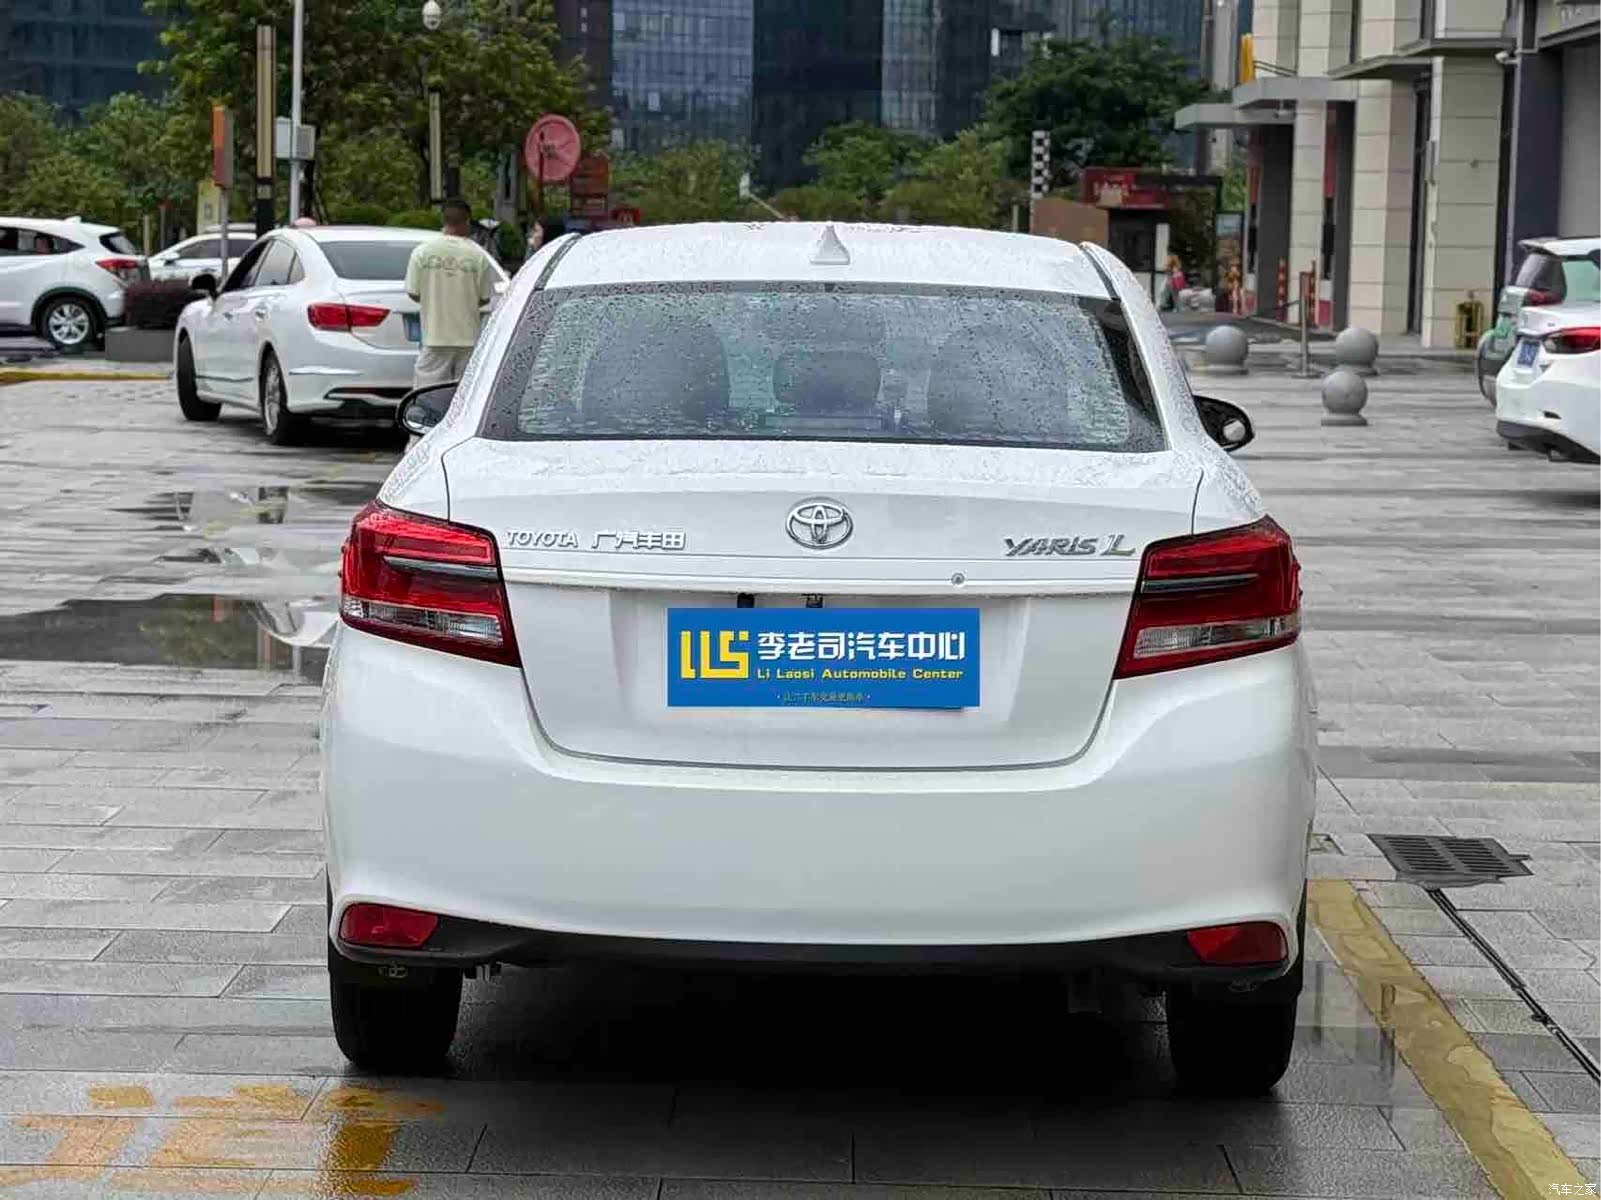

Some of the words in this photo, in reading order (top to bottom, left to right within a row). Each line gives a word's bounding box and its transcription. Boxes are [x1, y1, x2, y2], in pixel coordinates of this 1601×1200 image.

[506, 530, 579, 548] TOYOTA
[591, 530, 687, 550] 广汽丰田
[1003, 536, 1098, 557] YARIS
[1100, 533, 1137, 556] L
